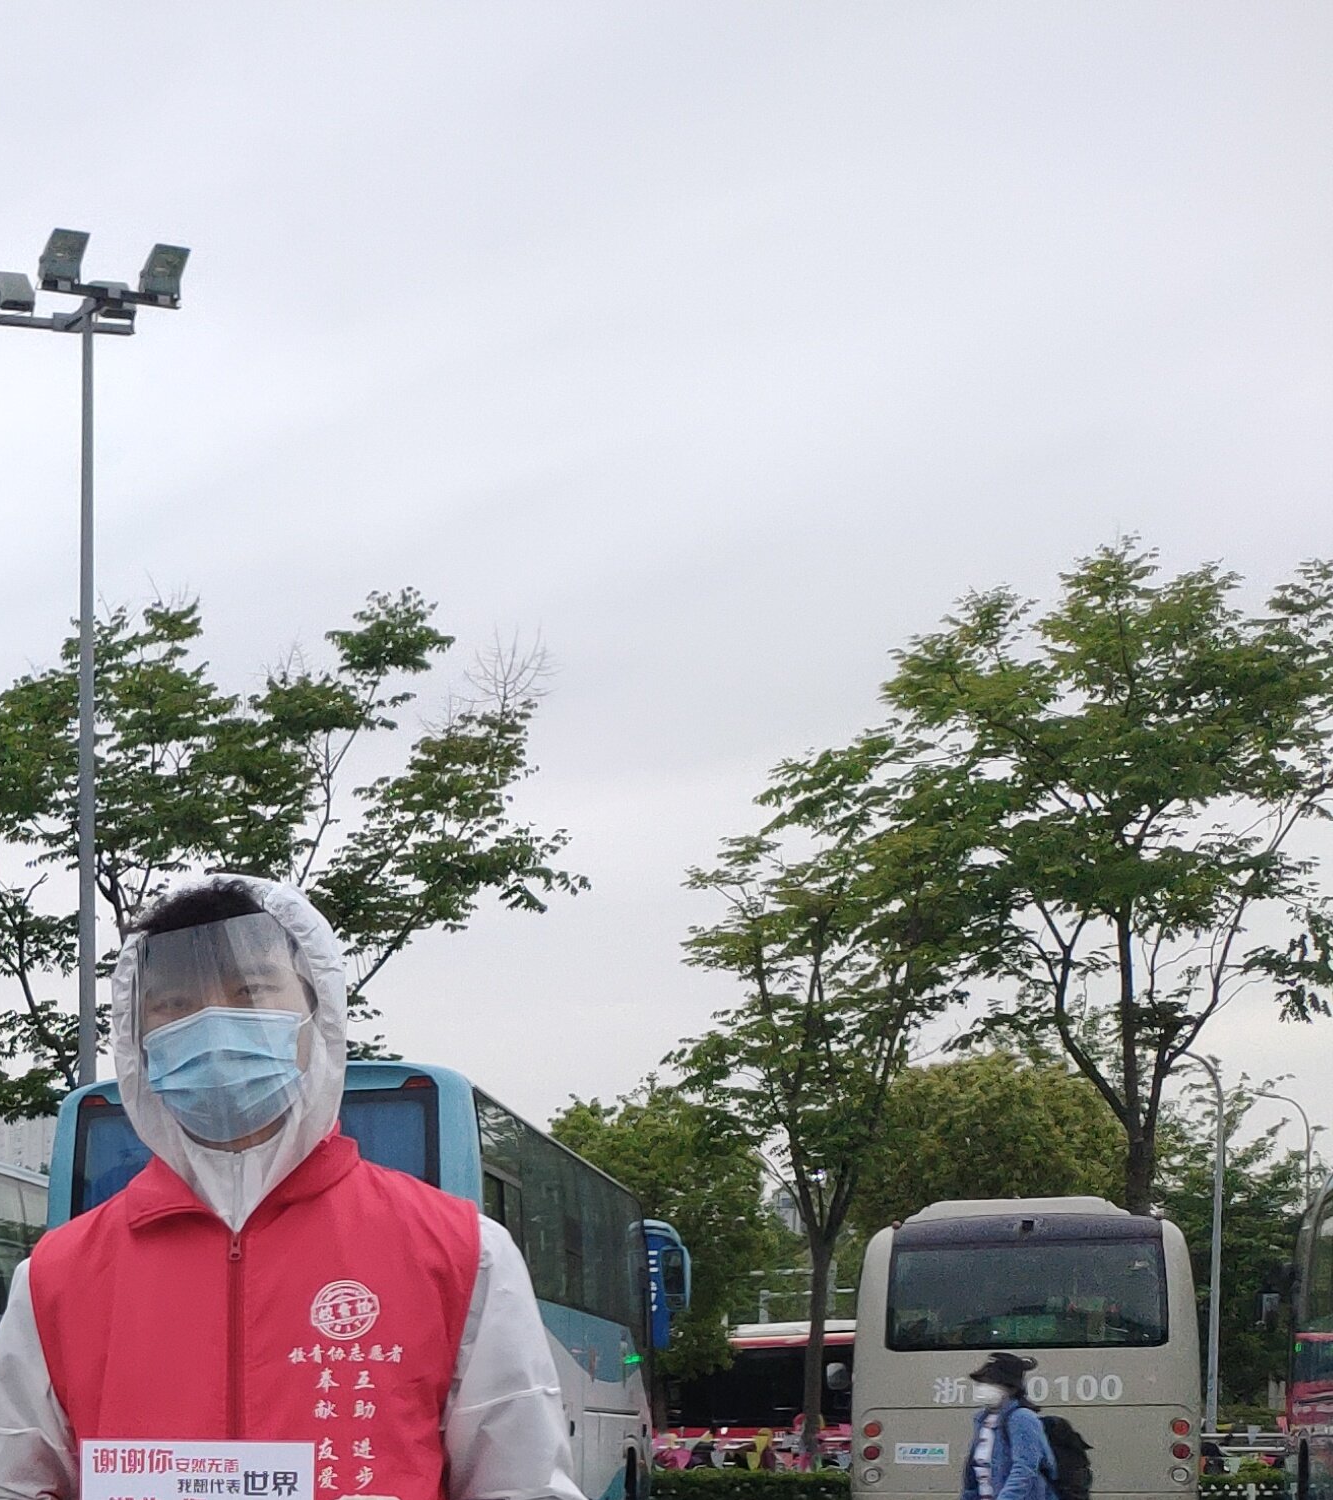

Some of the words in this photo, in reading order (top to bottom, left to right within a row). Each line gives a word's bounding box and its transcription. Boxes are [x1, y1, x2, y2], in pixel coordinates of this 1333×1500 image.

[288, 1343, 404, 1364] 校青协志愿者
[92, 1448, 239, 1474] 谢谢你安然无恙
[177, 1470, 299, 1497] 我想代表世界
